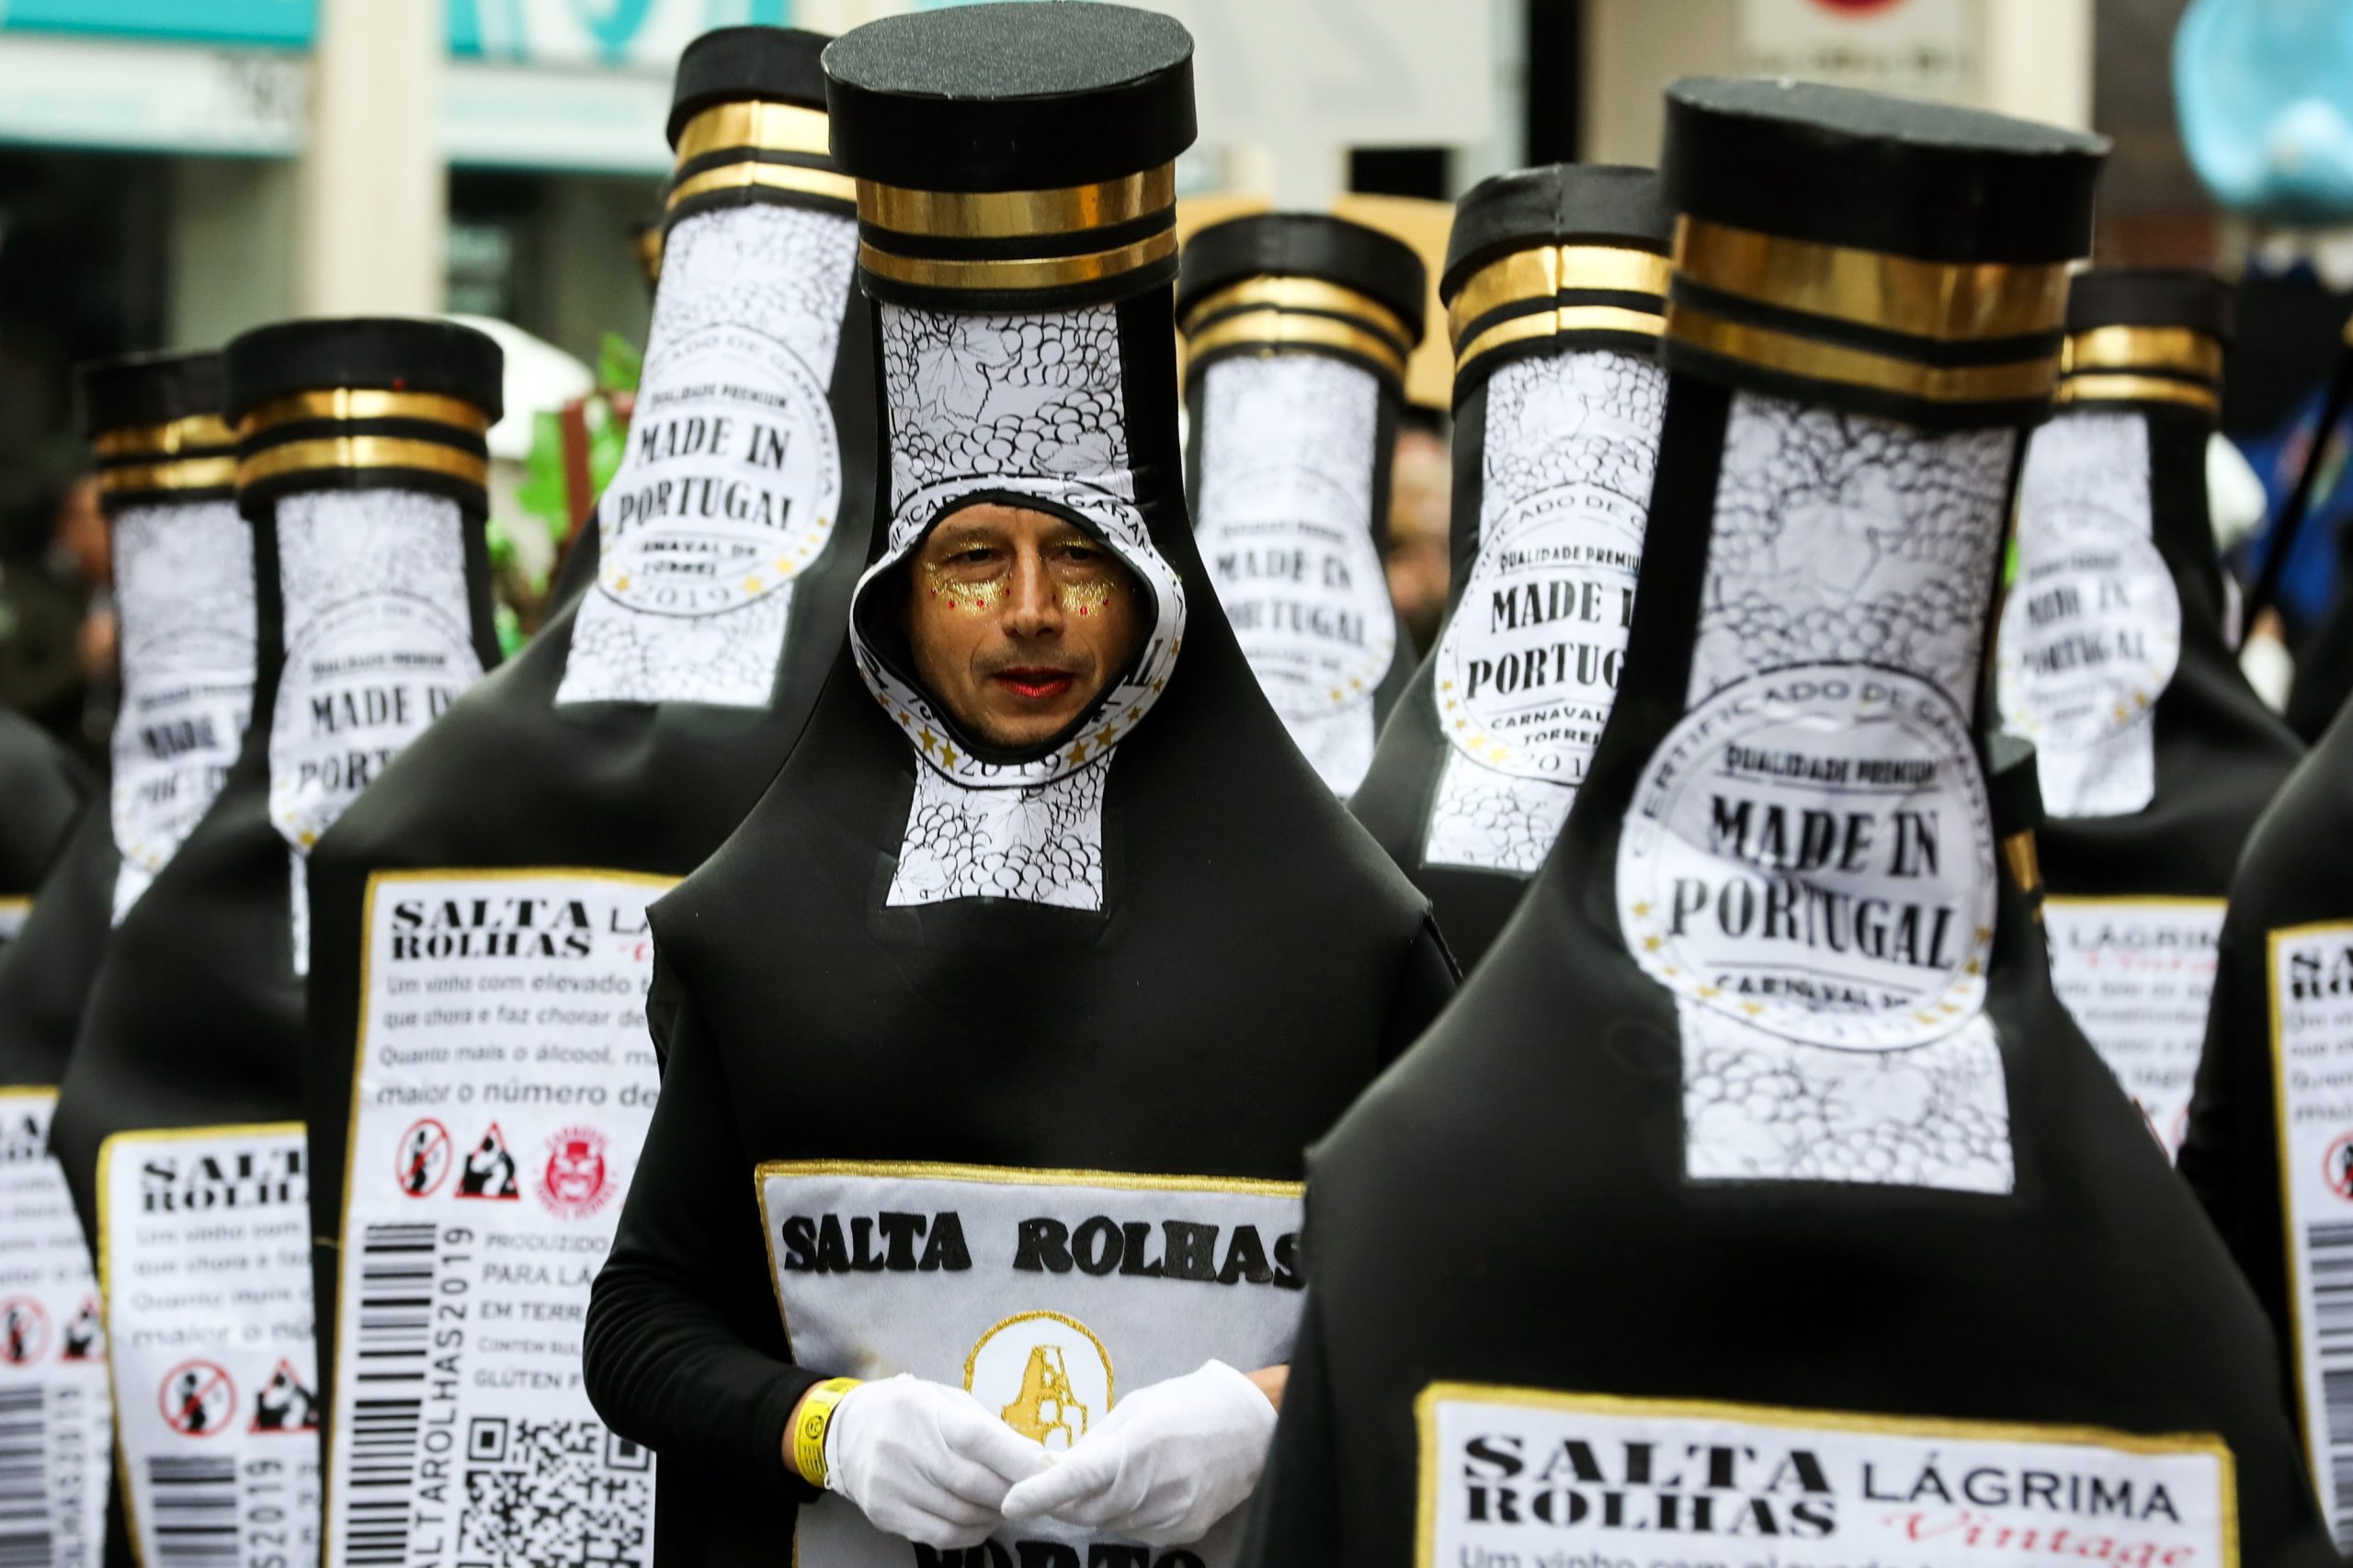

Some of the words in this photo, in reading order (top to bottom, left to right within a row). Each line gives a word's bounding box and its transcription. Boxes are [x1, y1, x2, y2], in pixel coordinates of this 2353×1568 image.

[637, 416, 733, 467] MADE
[745, 423, 790, 471] IN
[617, 476, 798, 535] PORTUGAL
[1500, 547, 1580, 576] QUALIDADE
[1586, 547, 1641, 571] PREMIU
[1490, 580, 1603, 634] MADE
[311, 685, 410, 734] MADE
[1491, 706, 1606, 730] CARNAVAL
[1725, 743, 1846, 785] QUALIDADE
[1711, 793, 1876, 873] MADE
[1884, 810, 1940, 879] IN
[392, 897, 591, 930] SALTA
[1665, 876, 1956, 971] PORTUGAL
[392, 931, 593, 960] ROLHAS
[426, 972, 472, 994] vinho
[477, 974, 524, 993] com
[531, 971, 632, 995] elevado
[382, 1012, 417, 1030] que
[424, 1006, 472, 1027] chora
[477, 1007, 490, 1025] e
[497, 1004, 529, 1025] faz
[536, 1006, 610, 1027] chorar
[379, 1046, 449, 1067] Quanto
[455, 1044, 505, 1062] mais
[512, 1045, 529, 1062] o
[376, 1079, 450, 1106] maior
[457, 1083, 474, 1104] o
[482, 1077, 608, 1106] número
[484, 1232, 609, 1254] PRODUZIDO
[781, 1211, 972, 1273] SALTA
[1012, 1215, 1306, 1291] ROLHAS
[482, 1263, 551, 1286] PARA
[479, 1300, 512, 1321] EM
[1463, 1435, 1834, 1494] SALTA
[1861, 1452, 2181, 1523] LÁGRIMA
[1466, 1484, 1838, 1539] ROLHAS
[1880, 1506, 2198, 1568] Vintage
